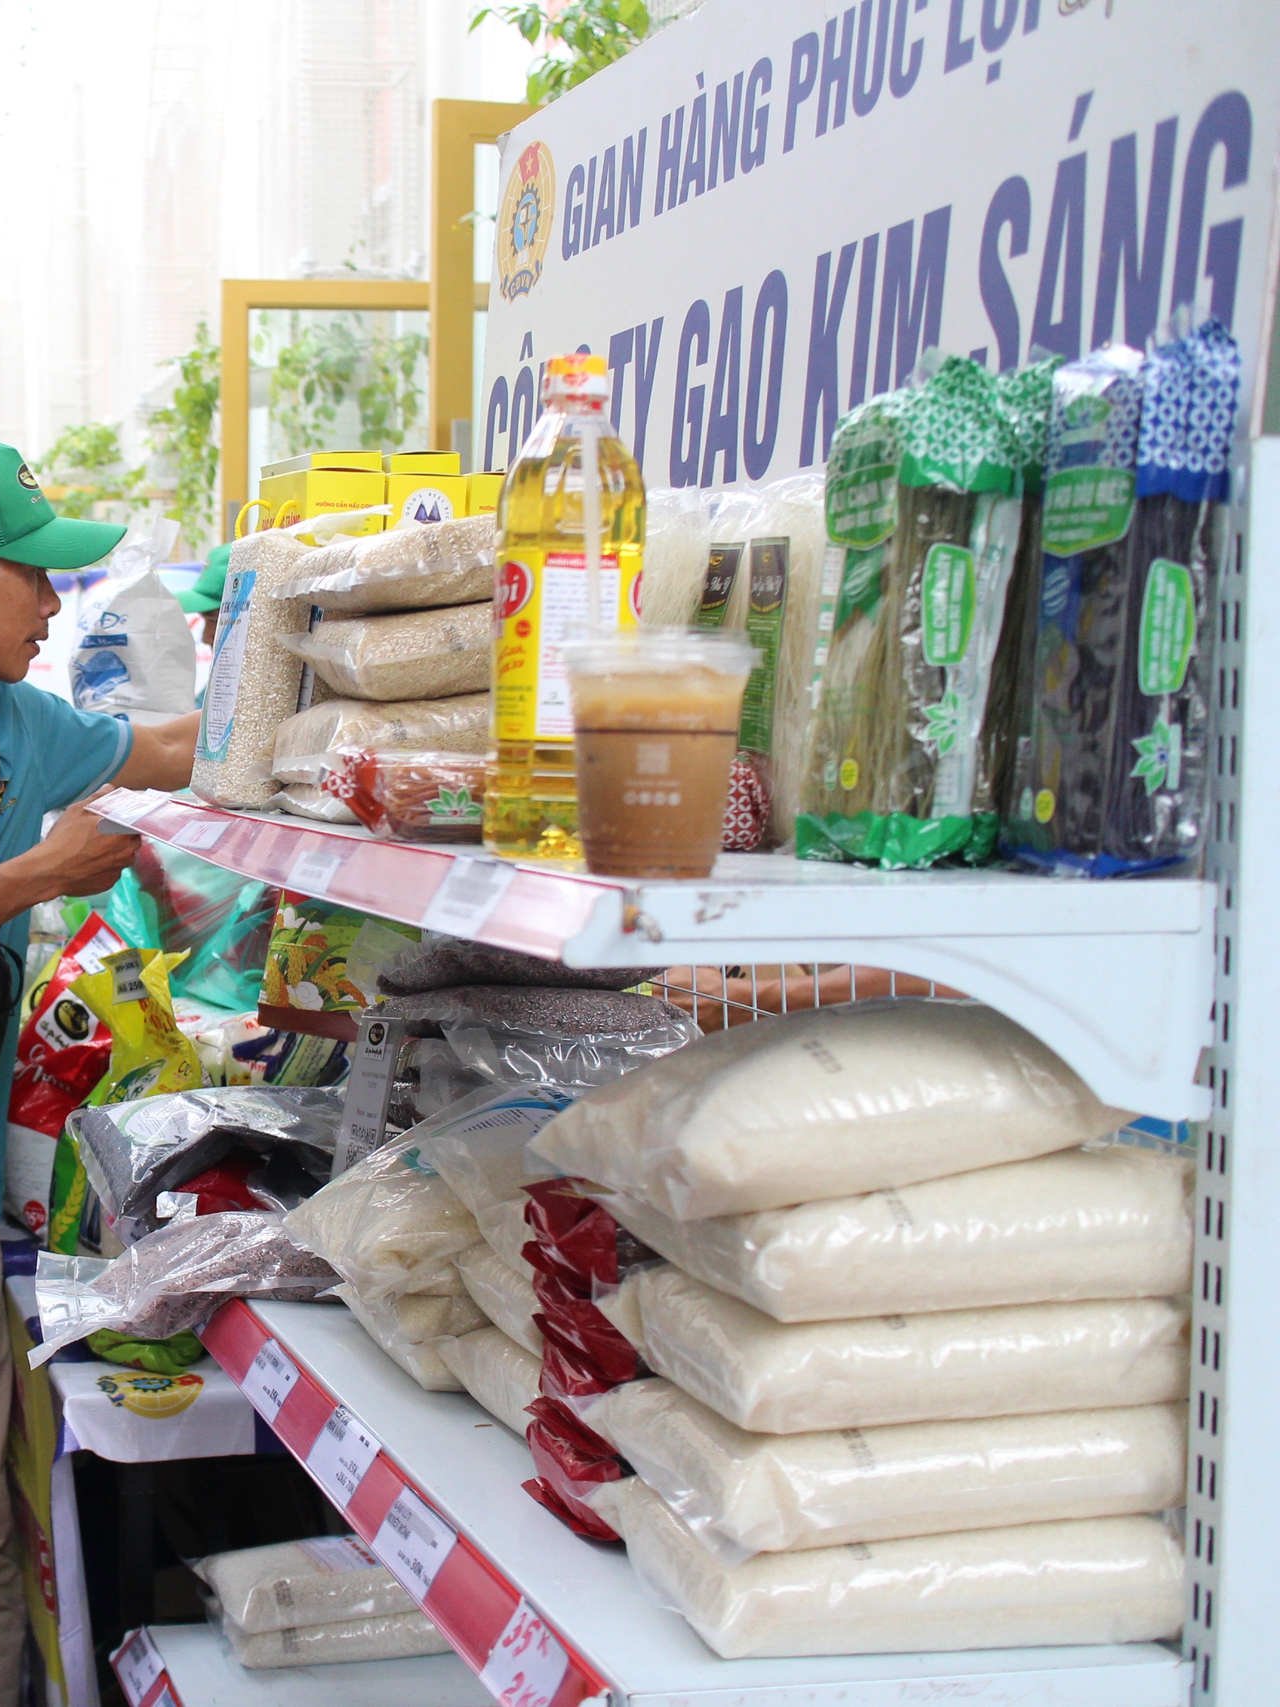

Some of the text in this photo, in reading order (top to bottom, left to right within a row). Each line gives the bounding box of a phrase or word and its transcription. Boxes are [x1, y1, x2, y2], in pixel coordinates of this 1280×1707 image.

[562, 126, 647, 261] GIAN
[654, 57, 773, 217] HÀNG
[608, 316, 664, 480] TY
[799, 204, 952, 468] KIM
[970, 89, 1253, 372] SÁNG
